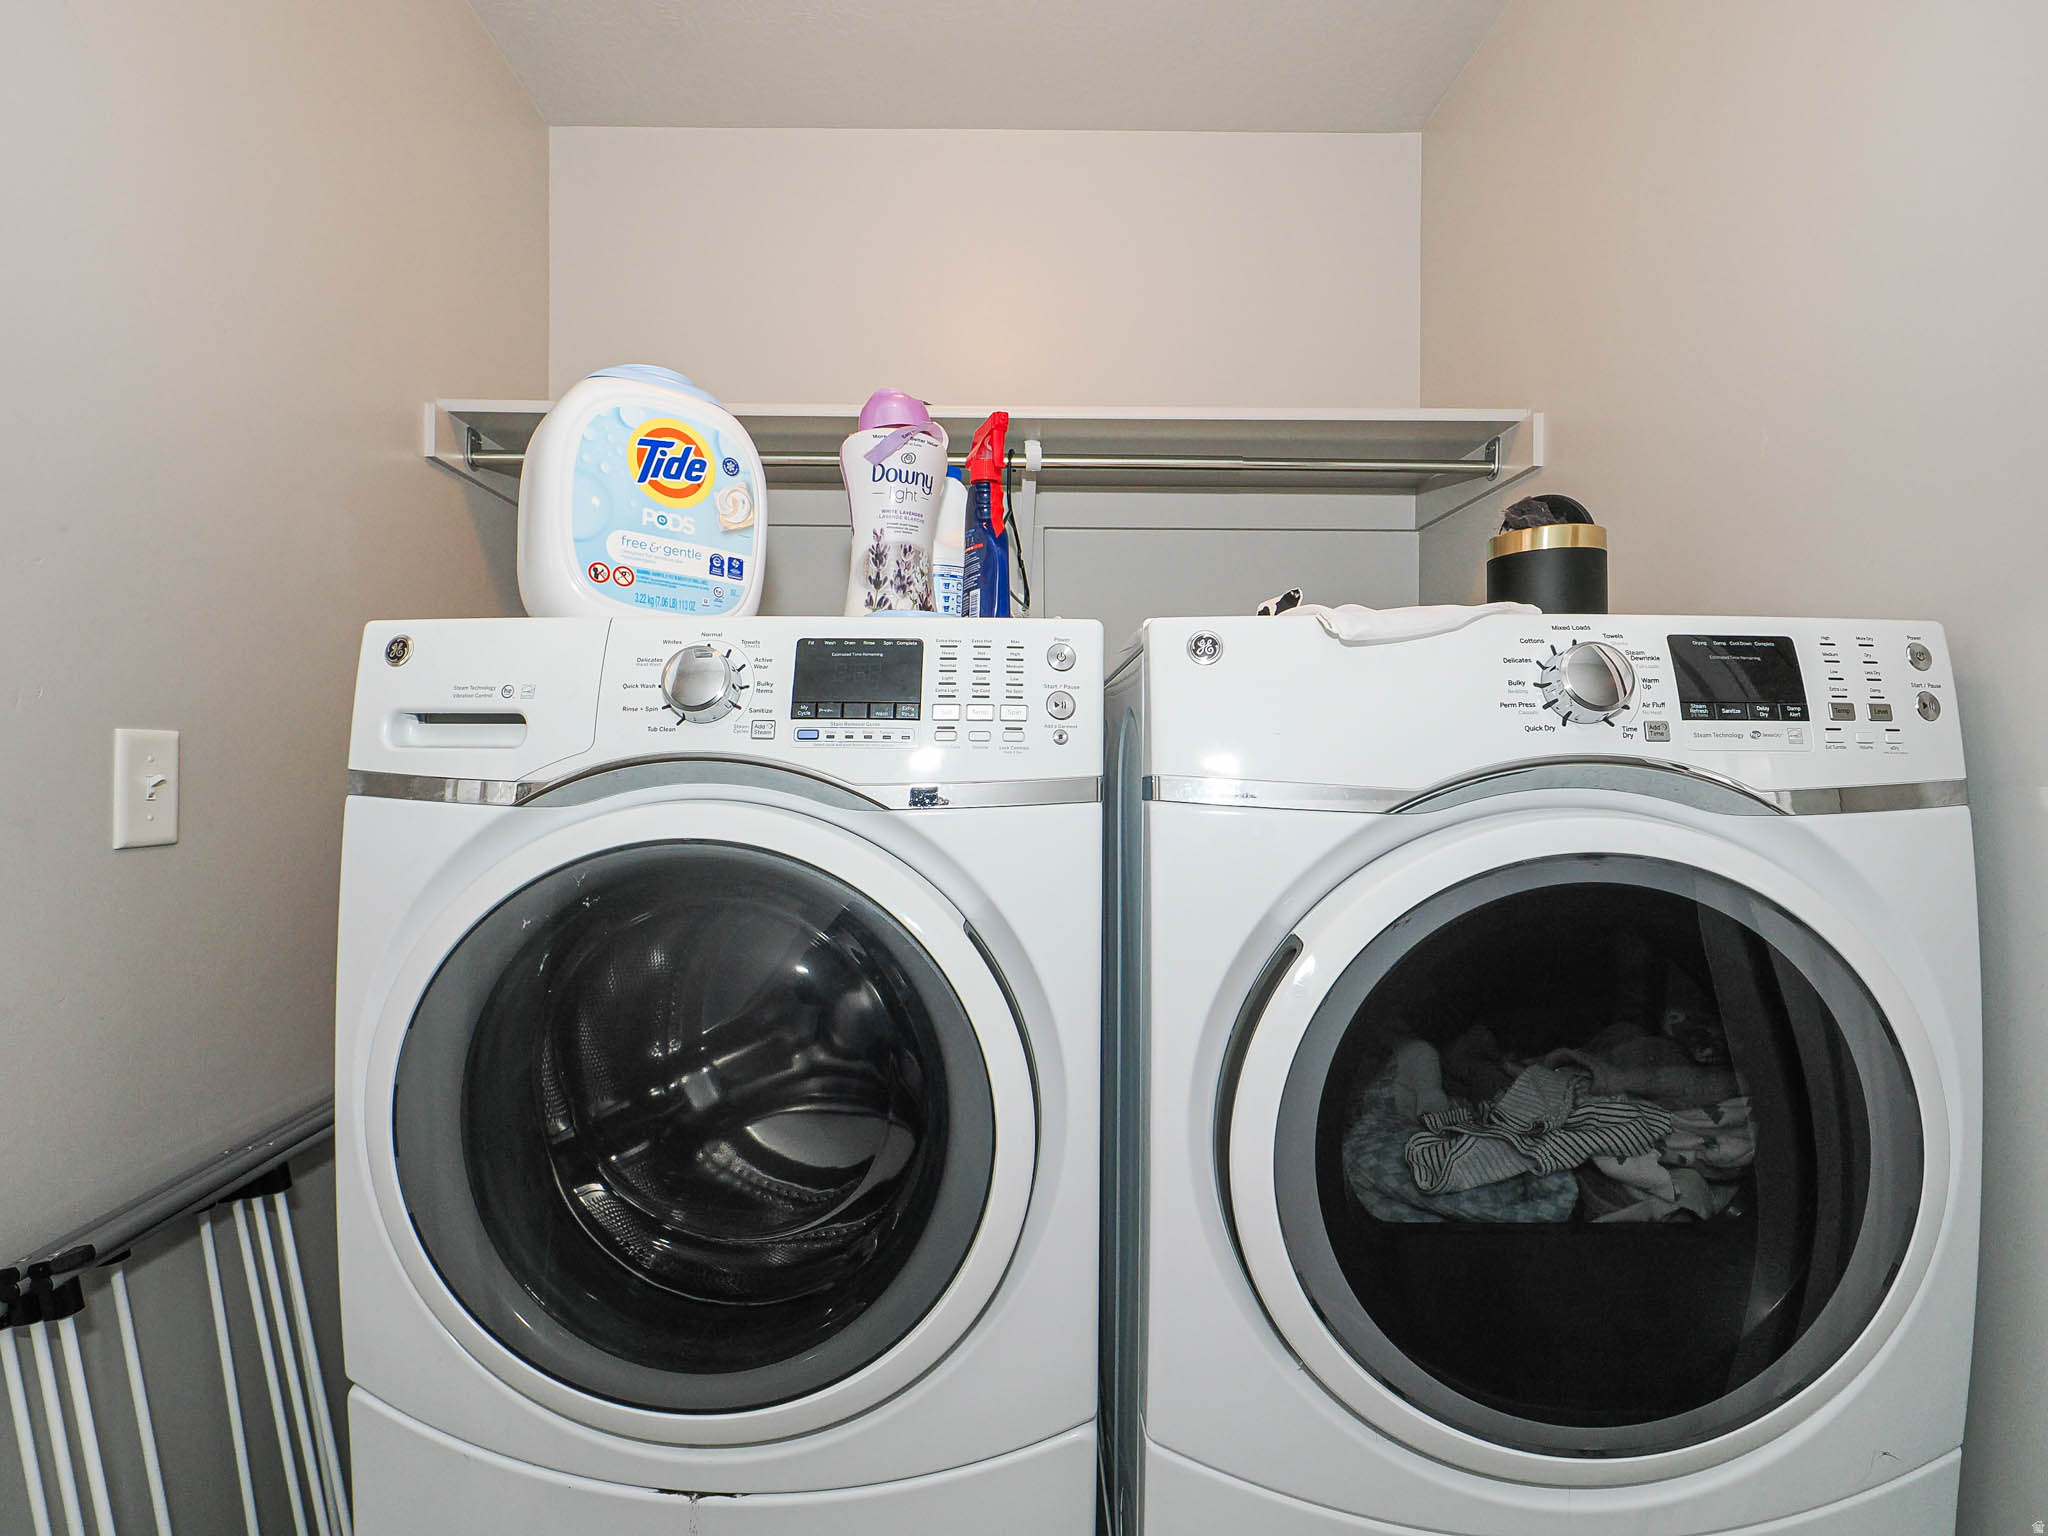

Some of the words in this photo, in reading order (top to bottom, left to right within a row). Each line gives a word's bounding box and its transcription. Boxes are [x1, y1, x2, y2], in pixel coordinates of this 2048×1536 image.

[636, 437, 709, 484] Tide
[871, 463, 934, 496] Downy
[641, 508, 696, 535] PODS
[621, 535, 648, 550] free
[649, 542, 661, 553] &
[663, 545, 702, 560] gentle
[634, 592, 647, 604] 3.22
[647, 594, 655, 608] kg
[1834, 707, 1851, 715] Temp
